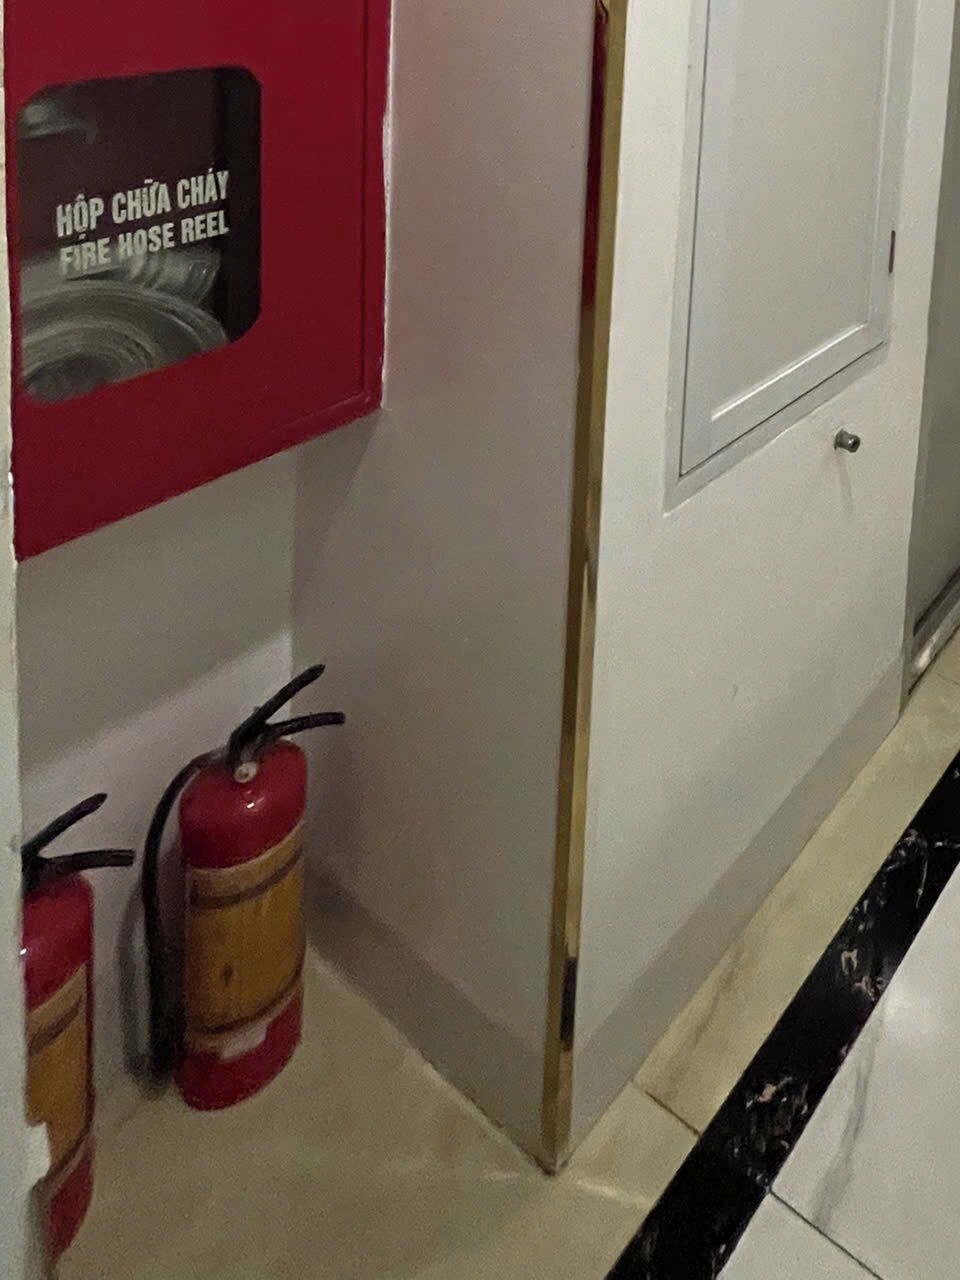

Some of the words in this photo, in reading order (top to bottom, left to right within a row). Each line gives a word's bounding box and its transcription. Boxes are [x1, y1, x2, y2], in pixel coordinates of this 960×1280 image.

[55, 193, 105, 240] HỘP
[111, 178, 173, 224] CHỮA
[176, 167, 230, 210] CHÁY
[59, 237, 112, 274] FIRE
[118, 222, 176, 260] HOSE
[181, 209, 230, 245] REEL
